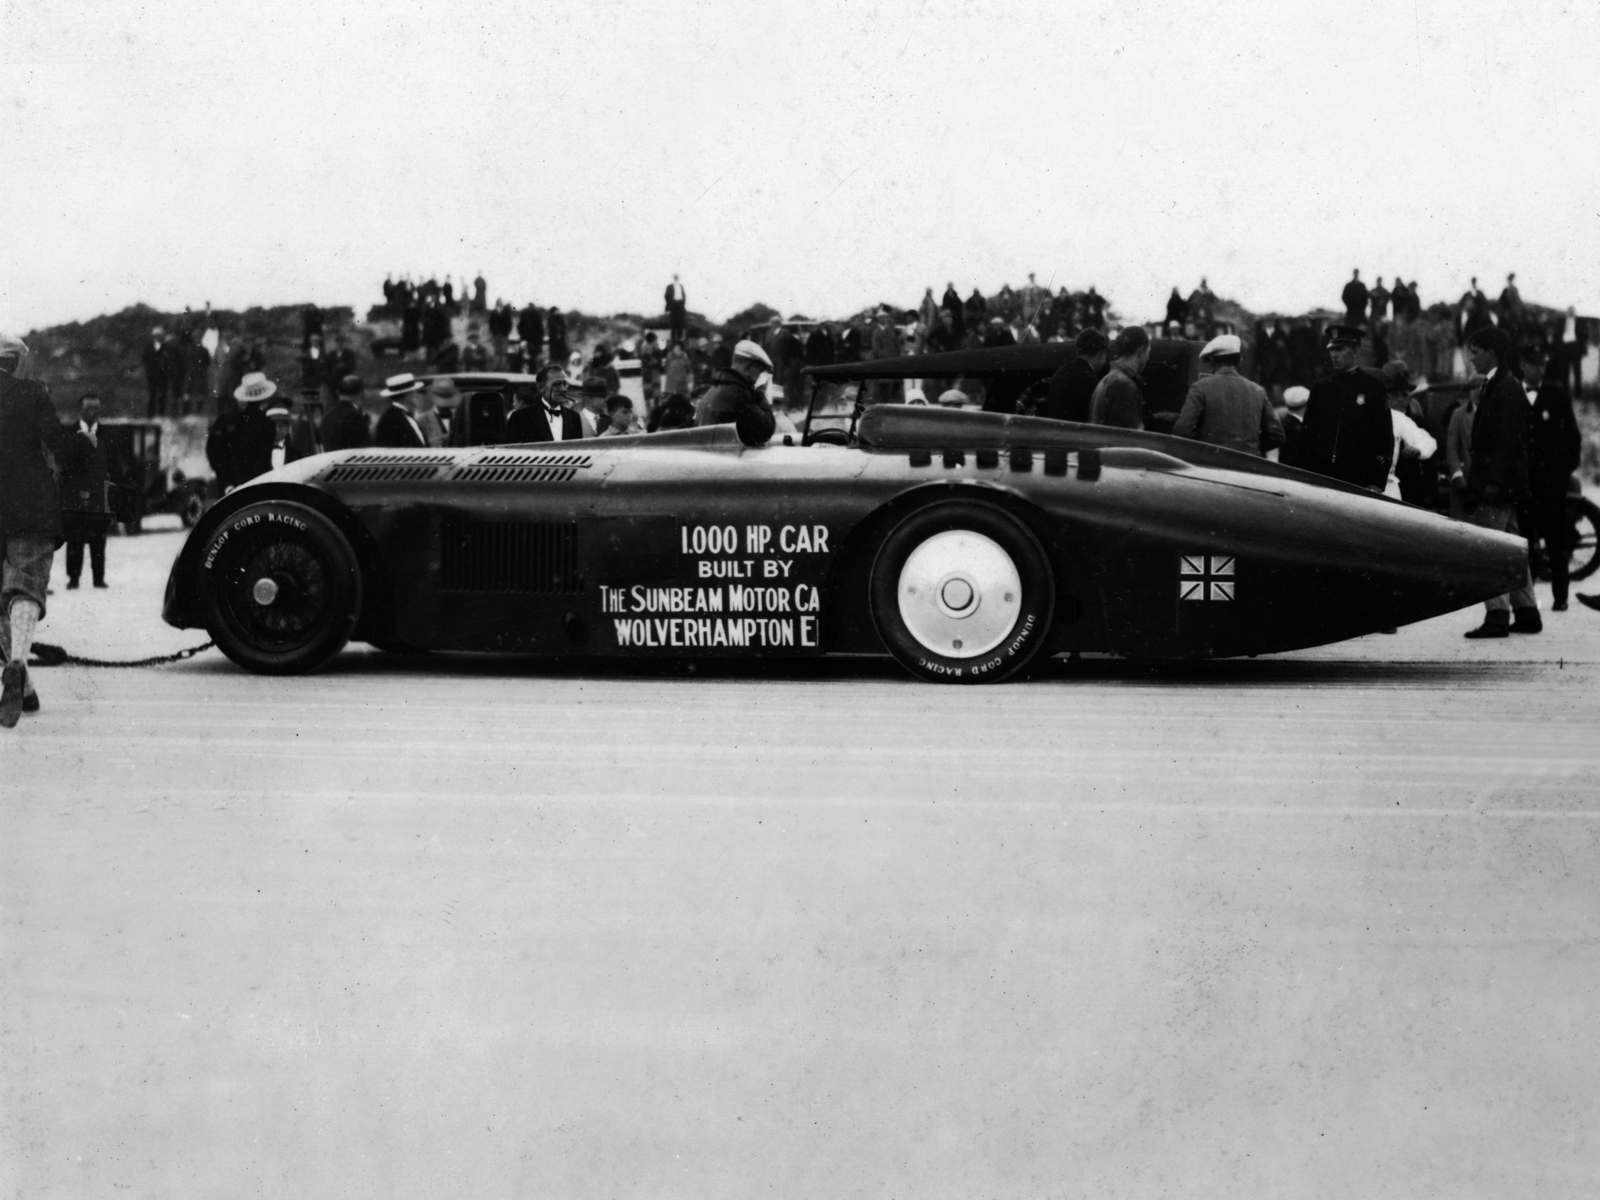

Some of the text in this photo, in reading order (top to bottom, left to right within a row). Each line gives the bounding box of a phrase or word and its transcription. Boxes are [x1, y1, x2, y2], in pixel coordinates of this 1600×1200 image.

[205, 512, 307, 569] DUNLOP CORD RACING
[746, 525, 775, 553] HP.
[780, 525, 829, 553] CAR
[699, 560, 793, 577] BUILT BY
[599, 585, 627, 612] THE
[630, 585, 723, 612] SUNBEAM
[729, 584, 791, 612] MOTOR
[614, 618, 794, 646] WOLVERHAMPTON
[919, 614, 1036, 676] DUNLOP CORD RACING
